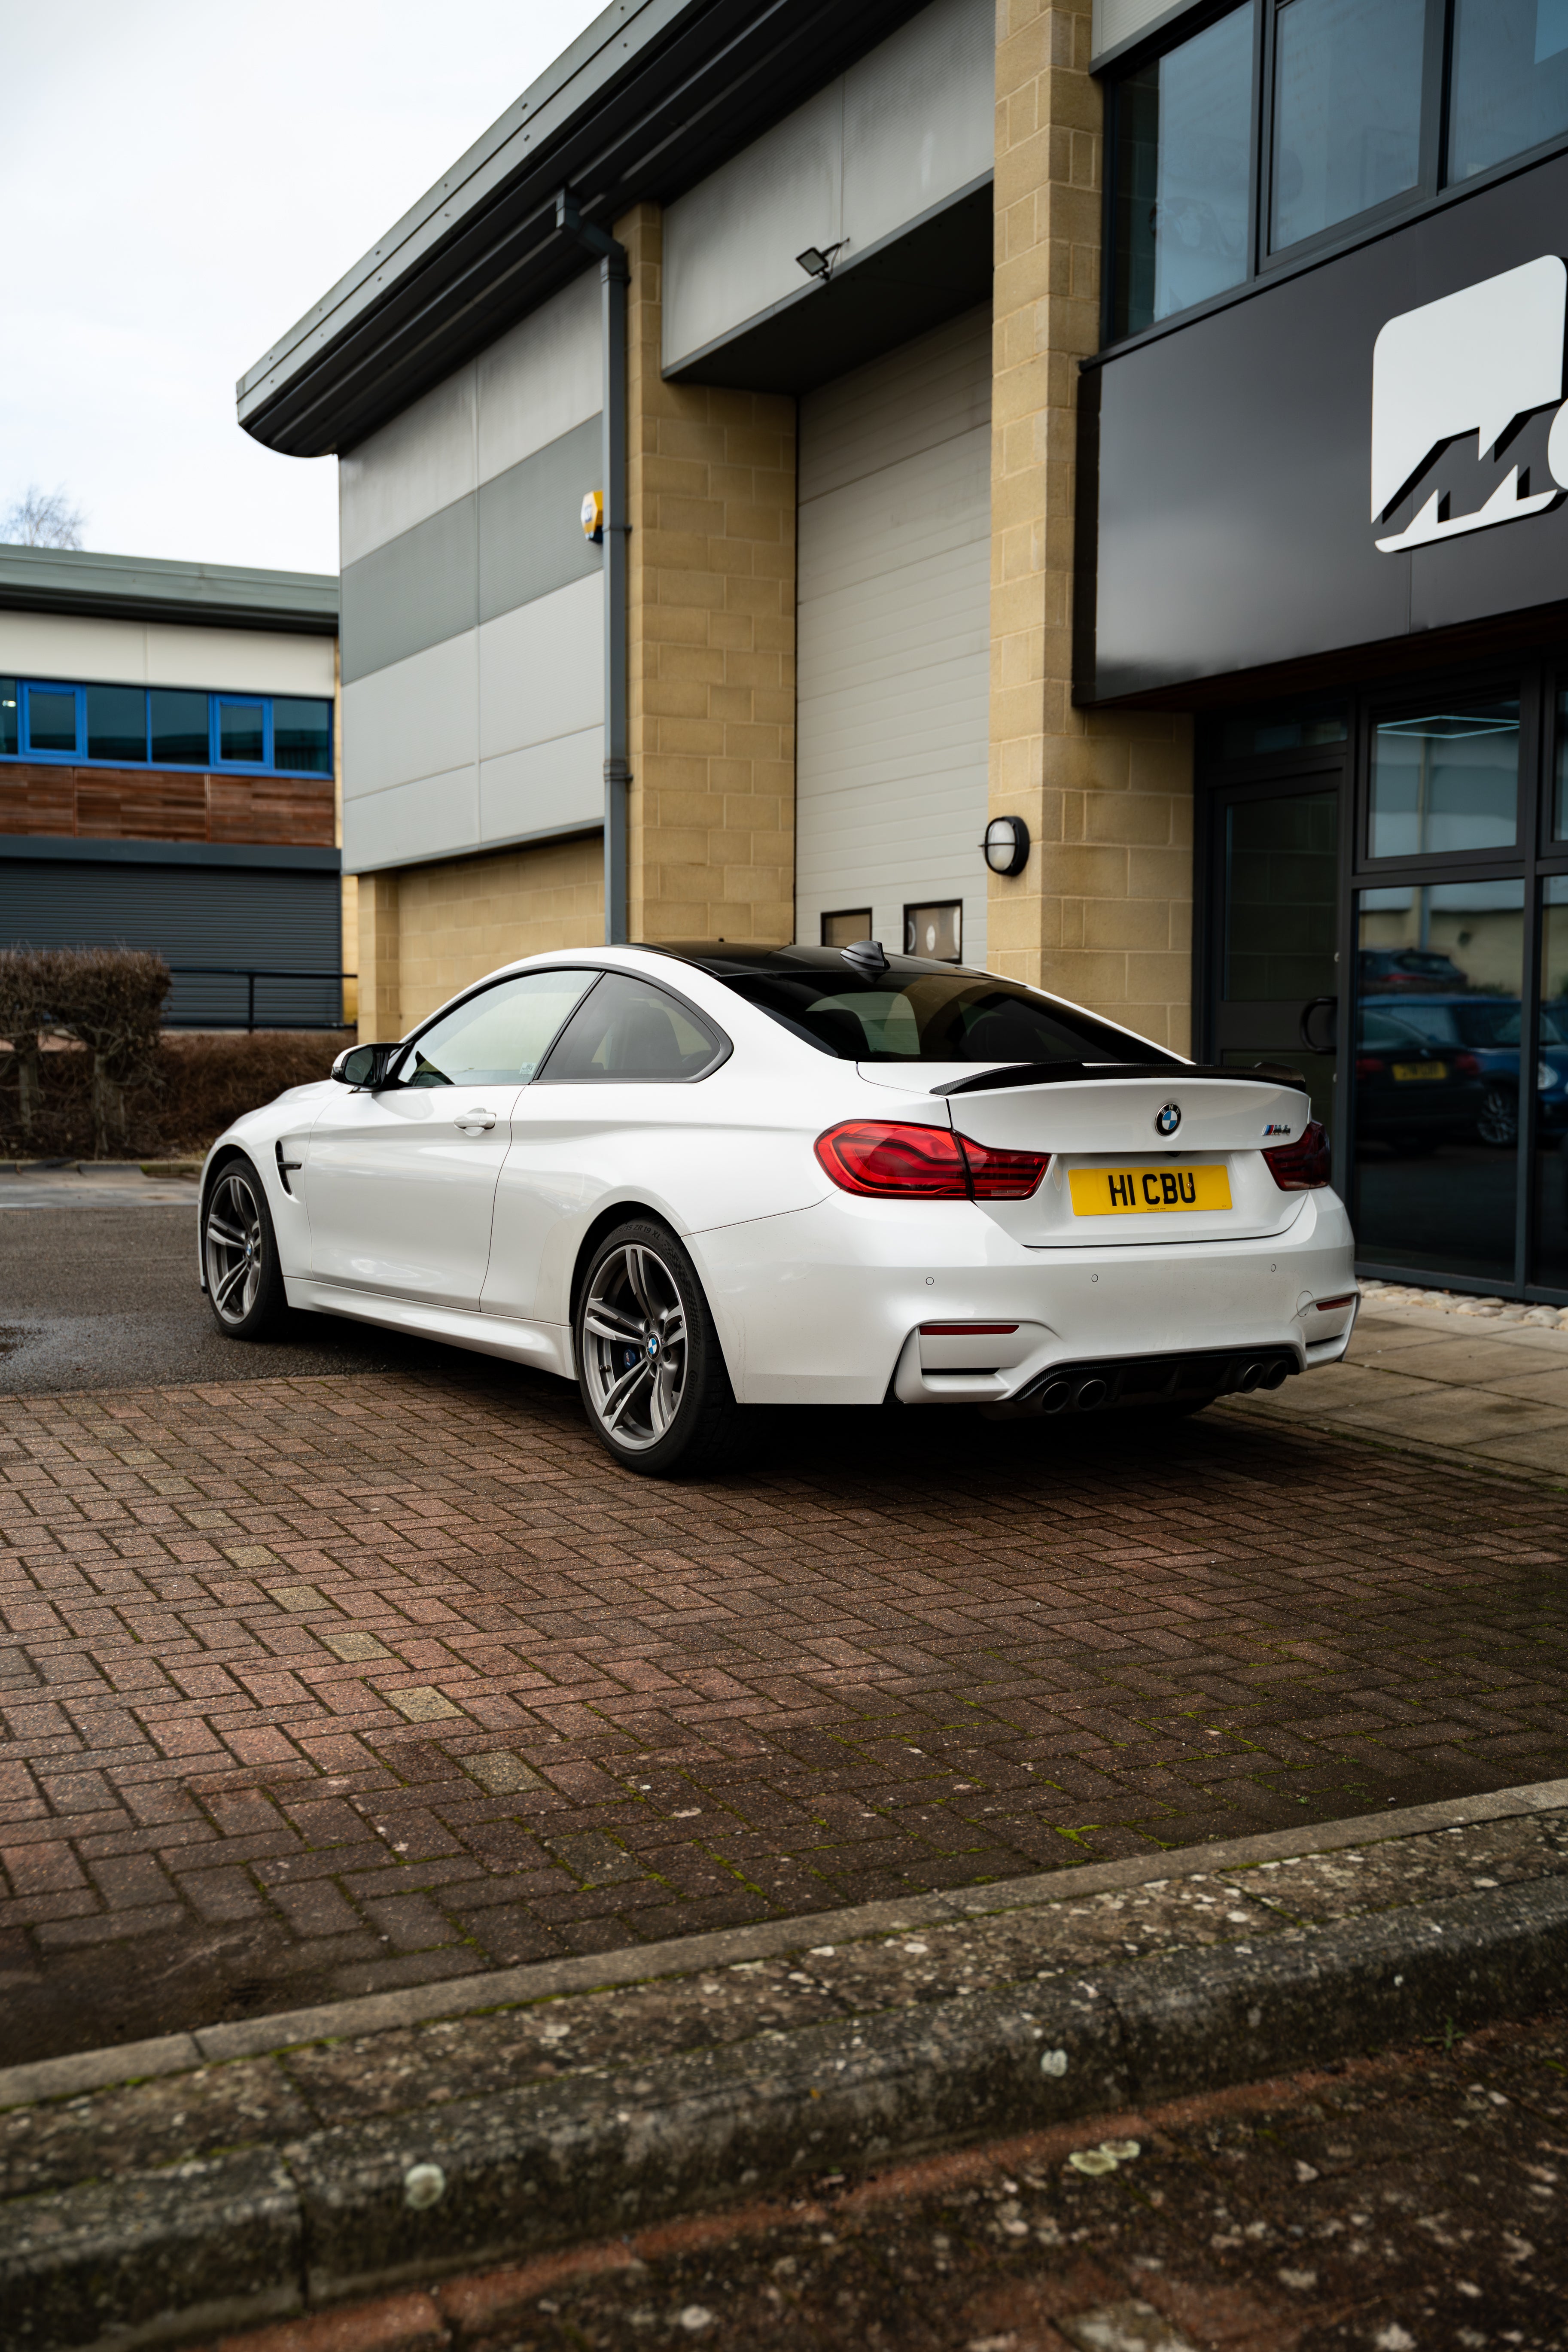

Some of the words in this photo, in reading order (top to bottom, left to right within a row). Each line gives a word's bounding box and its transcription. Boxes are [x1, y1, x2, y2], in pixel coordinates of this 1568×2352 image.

[1269, 1124, 1291, 1136] M4
[1142, 1173, 1196, 1205] CBU
[652, 1230, 661, 1240] XL
